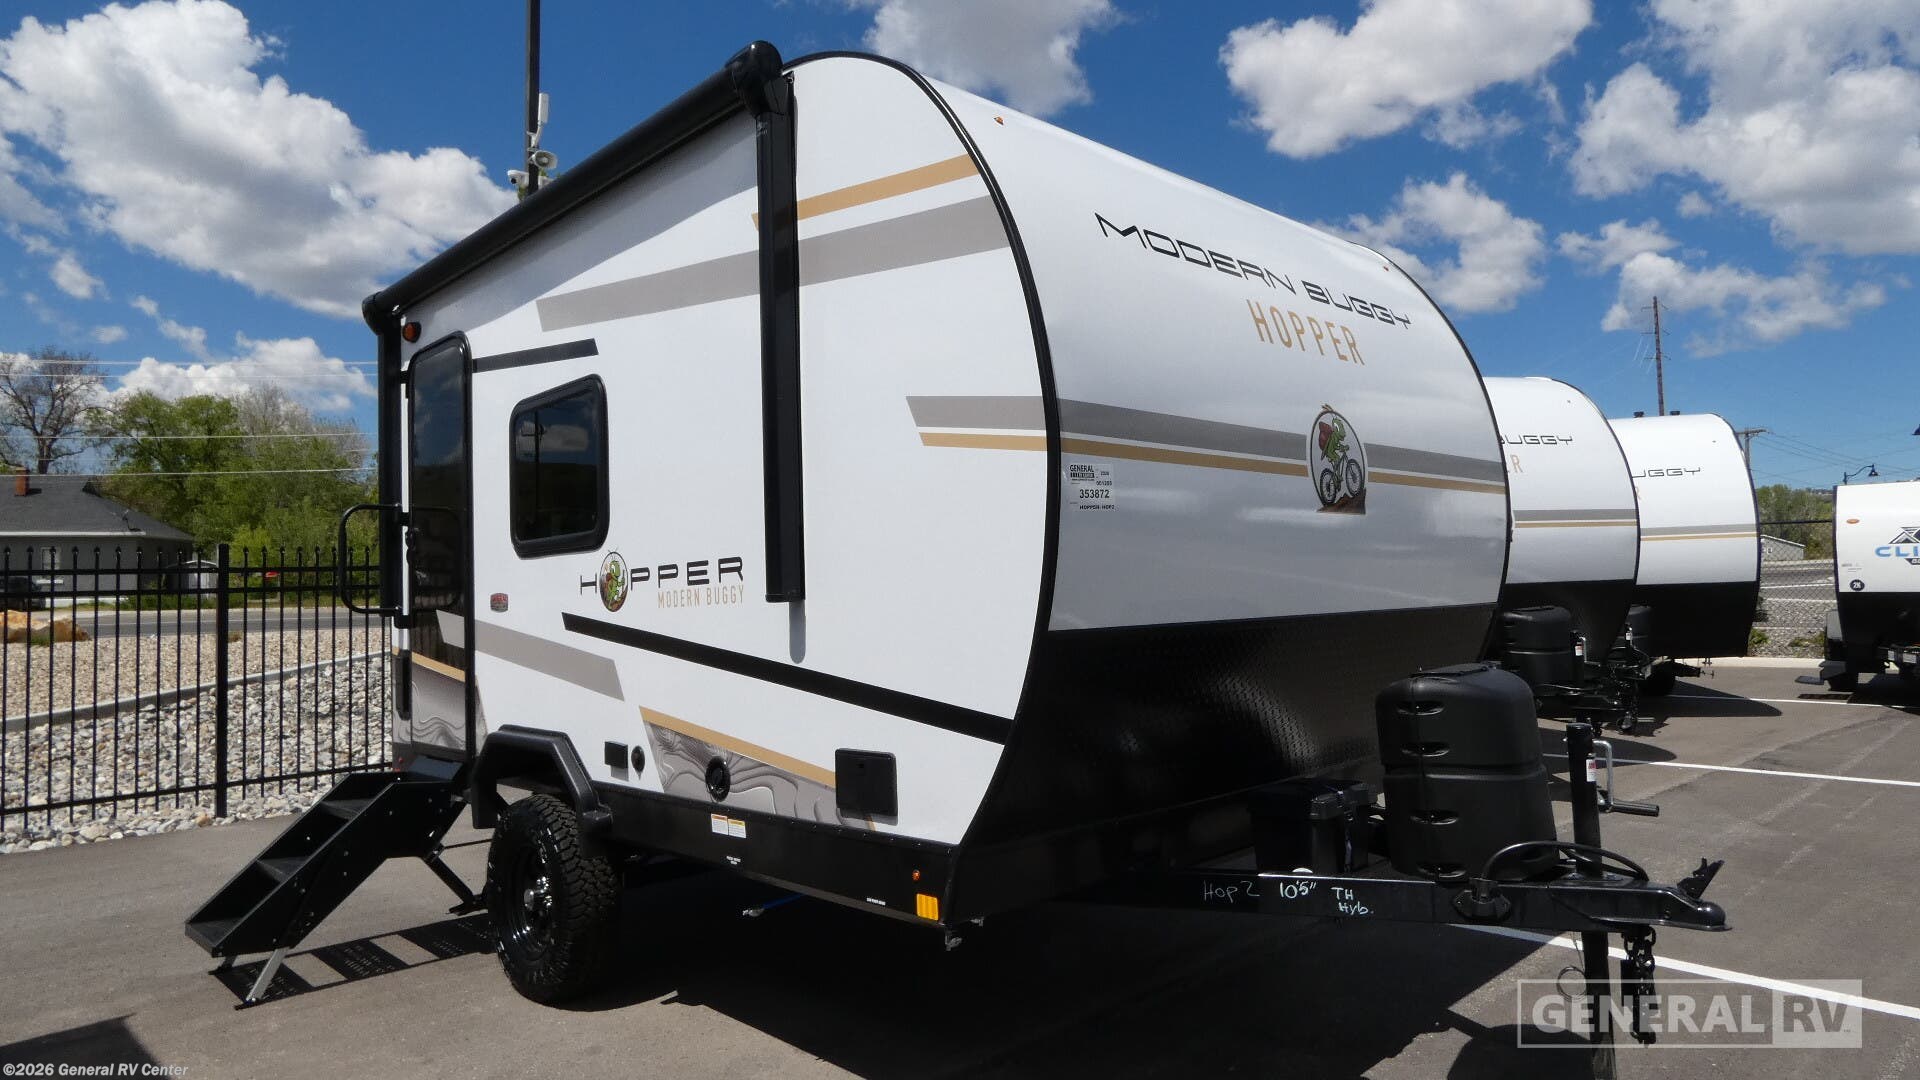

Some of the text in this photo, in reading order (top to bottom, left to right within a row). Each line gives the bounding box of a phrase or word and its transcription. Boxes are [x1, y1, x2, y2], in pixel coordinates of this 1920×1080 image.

[1094, 212, 1412, 329] MODERN BUGGY
[1246, 299, 1365, 365] HOPPER
[1631, 467, 1701, 478] UGGY
[1079, 489, 1110, 498] 353872
[657, 584, 744, 609] MODERN BUGGY
[1330, 887, 1354, 900] TH
